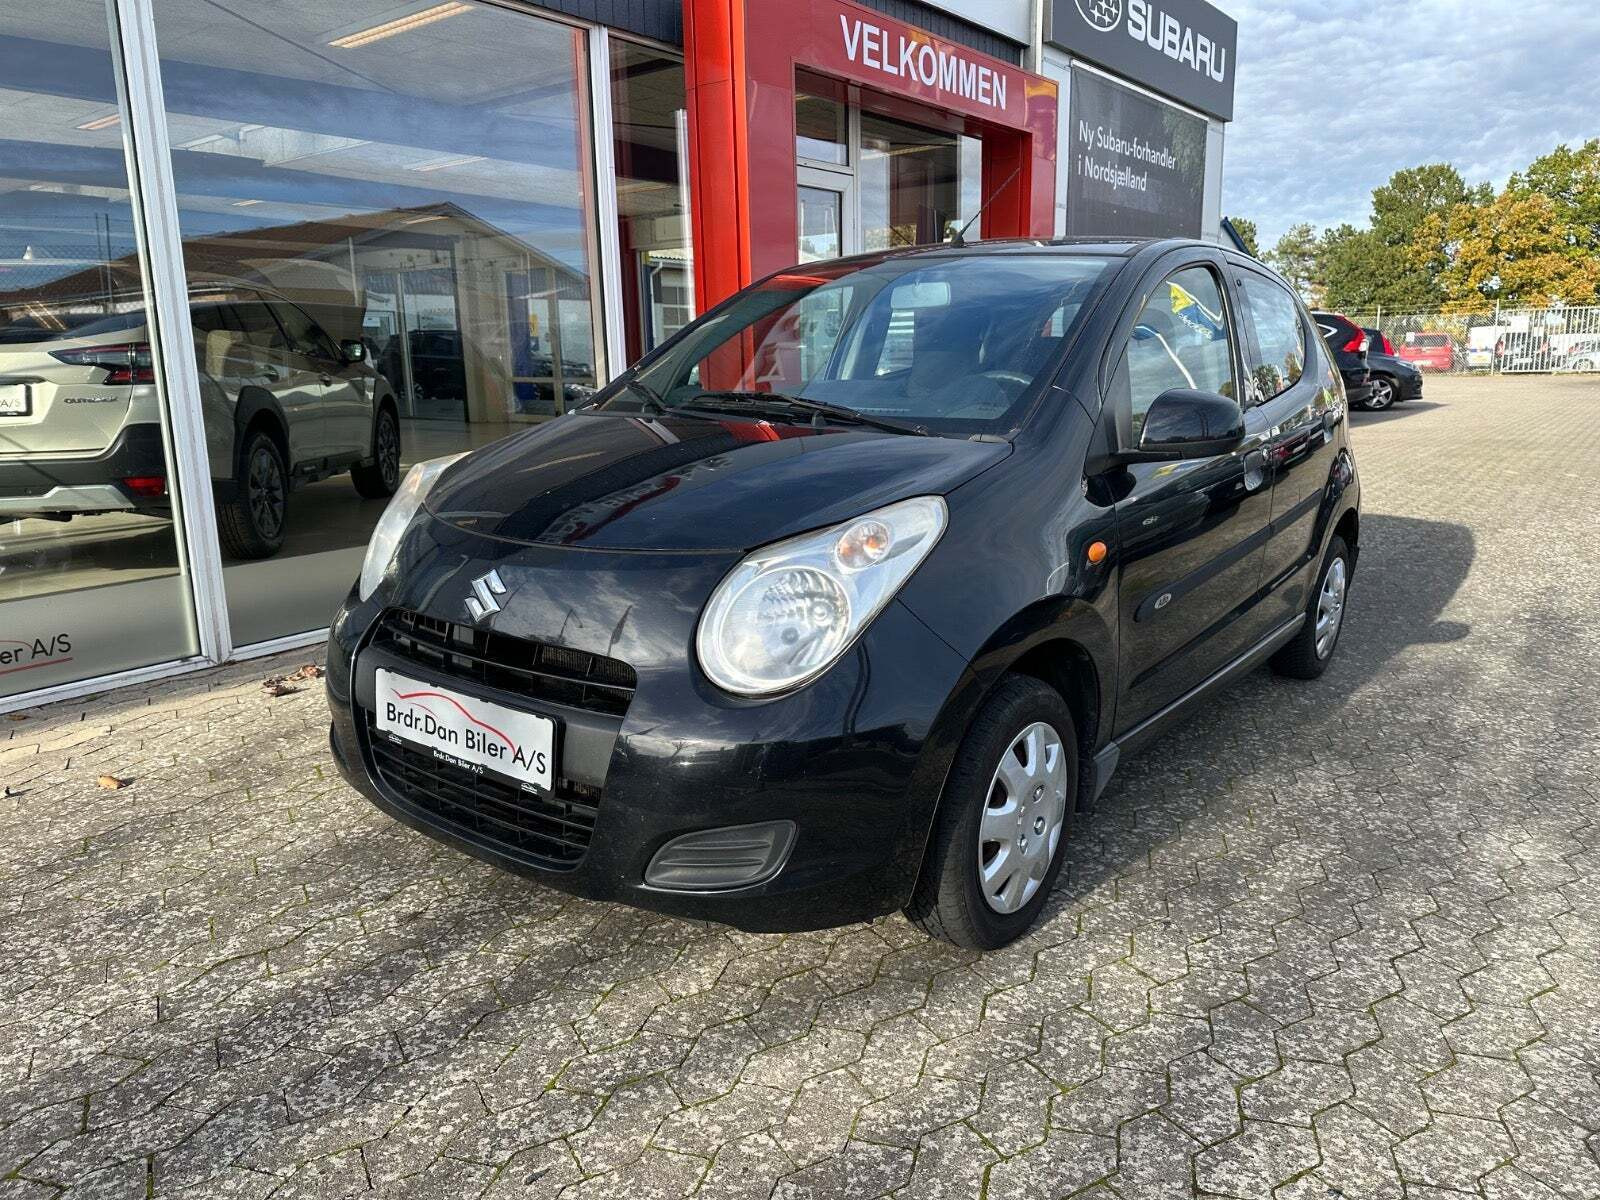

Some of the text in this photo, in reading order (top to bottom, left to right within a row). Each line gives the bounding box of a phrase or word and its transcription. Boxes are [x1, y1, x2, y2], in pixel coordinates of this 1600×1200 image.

[839, 14, 1006, 111] VELKOMMEN
[1127, 0, 1226, 83] SUBARU
[1079, 119, 1177, 170] Ny Subaru-forhandler
[1078, 154, 1148, 192] i Nordsjælland
[31, 633, 72, 659] A/S
[386, 702, 546, 775] Brdr.Dan Biler A/S
[457, 757, 471, 769] Biler
[471, 764, 484, 775] A/S
